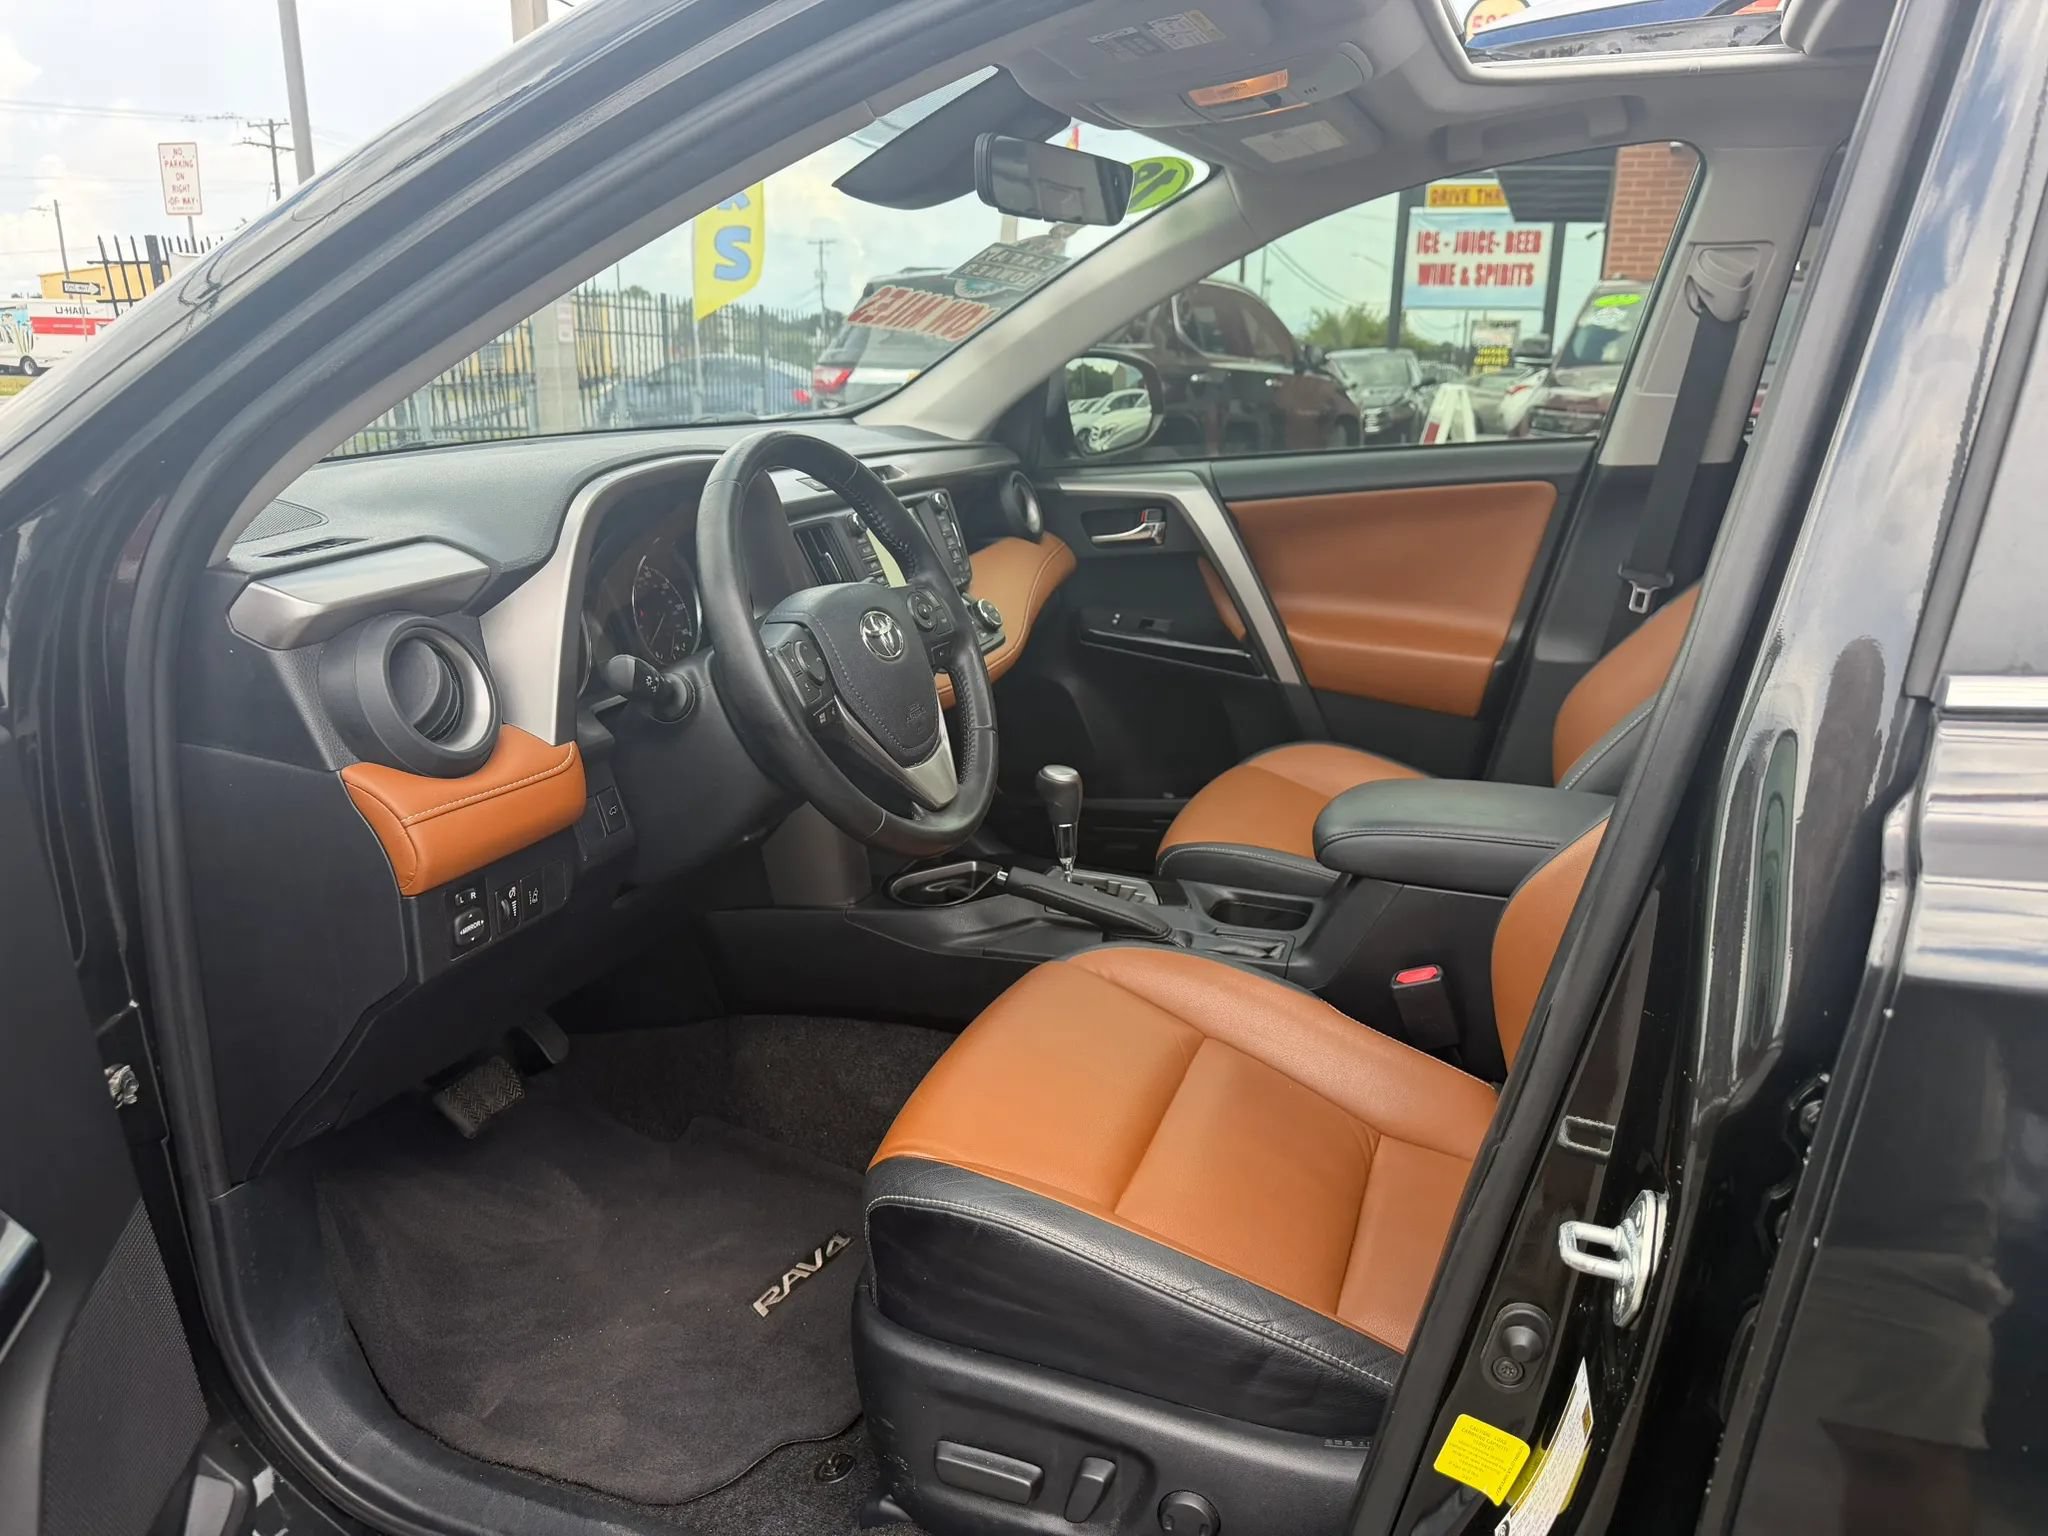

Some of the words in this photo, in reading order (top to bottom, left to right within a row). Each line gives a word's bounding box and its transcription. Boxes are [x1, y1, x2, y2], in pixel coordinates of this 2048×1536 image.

[173, 147, 183, 156] NO
[164, 160, 194, 168] PARKING
[175, 172, 185, 181] ON
[172, 184, 190, 193] RIGHT
[1431, 188, 1469, 204] DRIVE
[1477, 188, 1505, 204] THR
[1417, 230, 1440, 254] ICE
[1505, 230, 1542, 254] BEER
[1418, 263, 1456, 286] WINE
[1460, 266, 1470, 286] &
[1475, 263, 1534, 287] SPIRITS
[462, 920, 480, 934] MIRROR
[753, 1233, 851, 1318] RAV4
